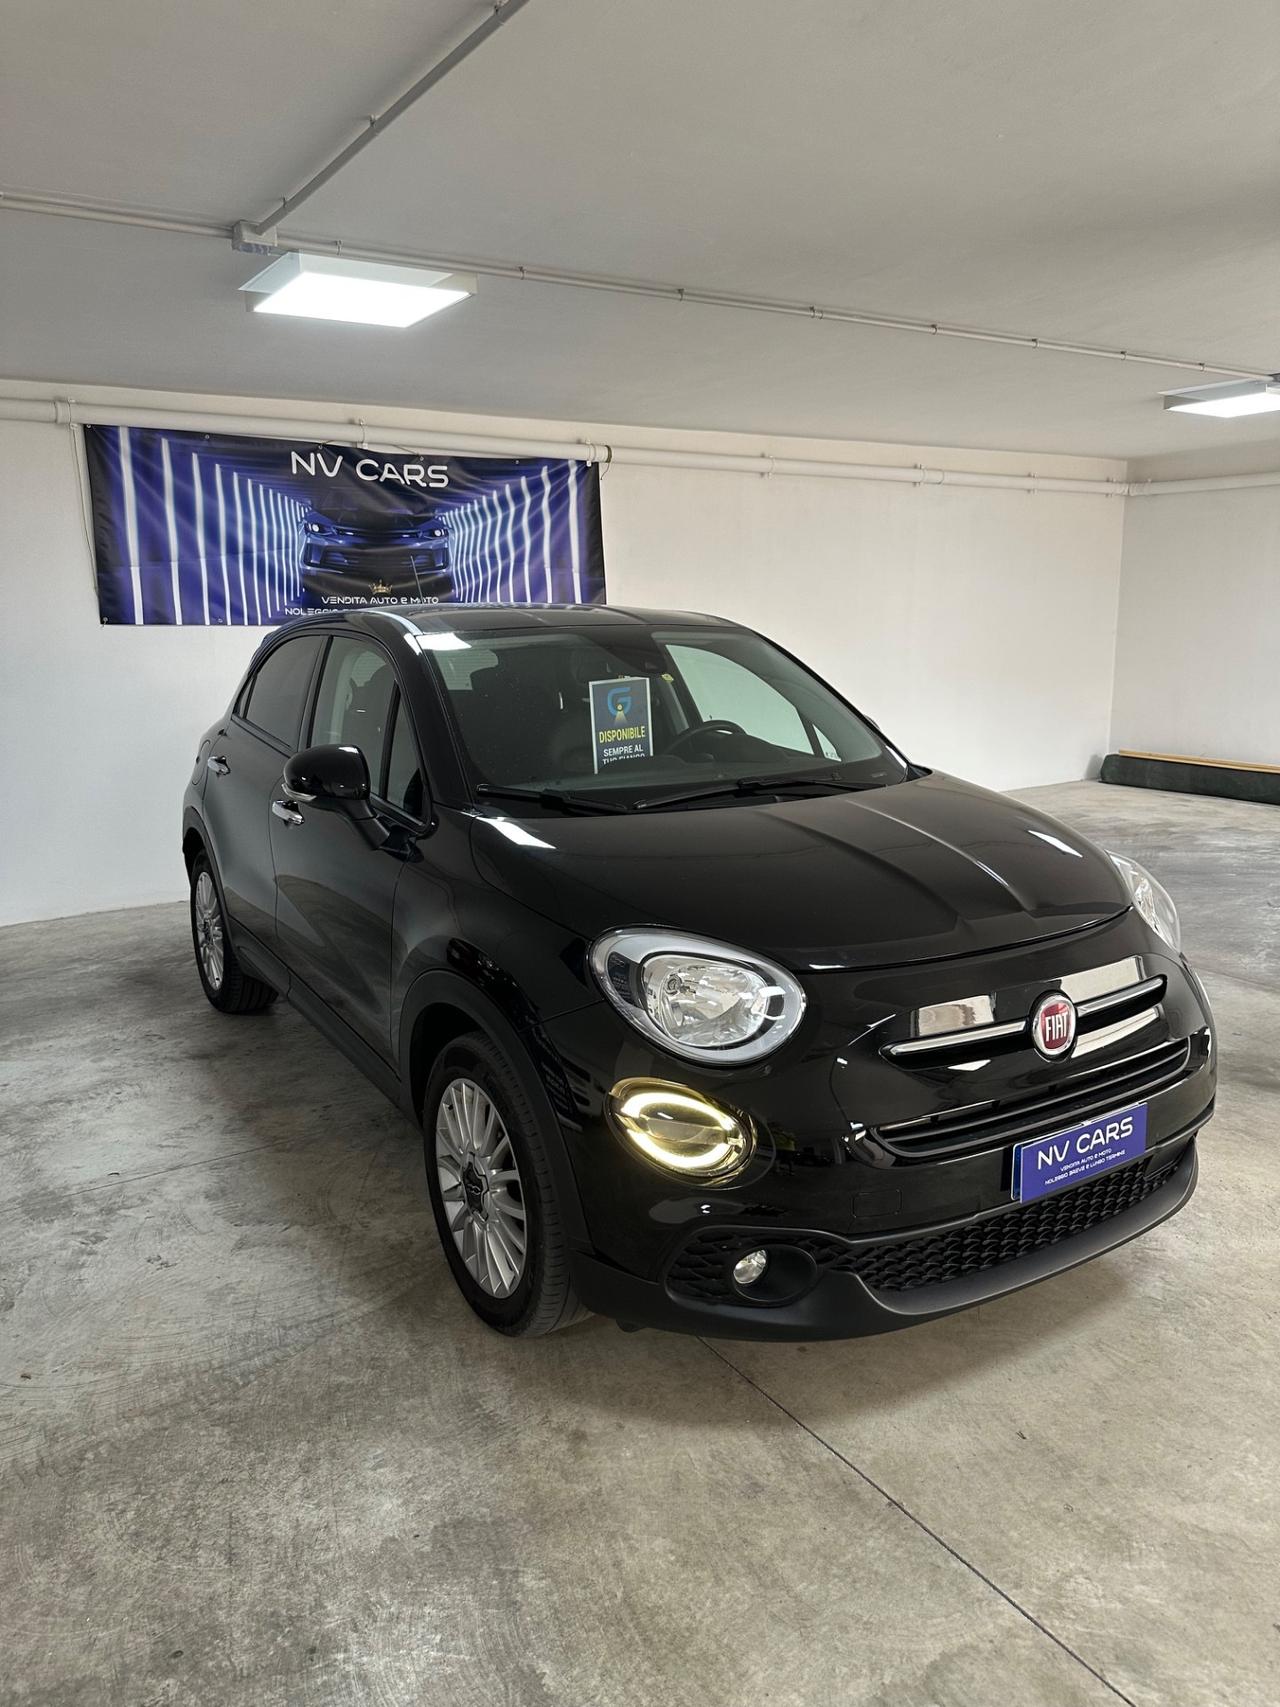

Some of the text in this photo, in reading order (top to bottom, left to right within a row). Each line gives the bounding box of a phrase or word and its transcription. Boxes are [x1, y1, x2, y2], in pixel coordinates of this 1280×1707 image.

[291, 451, 449, 488] NV CARS
[321, 596, 368, 605] VENDITA
[370, 596, 398, 605] AUTO
[599, 725, 646, 743] DISPONIBILE
[603, 745, 633, 757] SEMPRE
[634, 744, 644, 753] AL
[1045, 1011, 1069, 1042] FIAT
[1037, 1116, 1133, 1170] NV CARS
[1060, 1160, 1081, 1172] VENDITA
[1080, 1155, 1094, 1164] AUTO
[1098, 1148, 1112, 1157] MOTO
